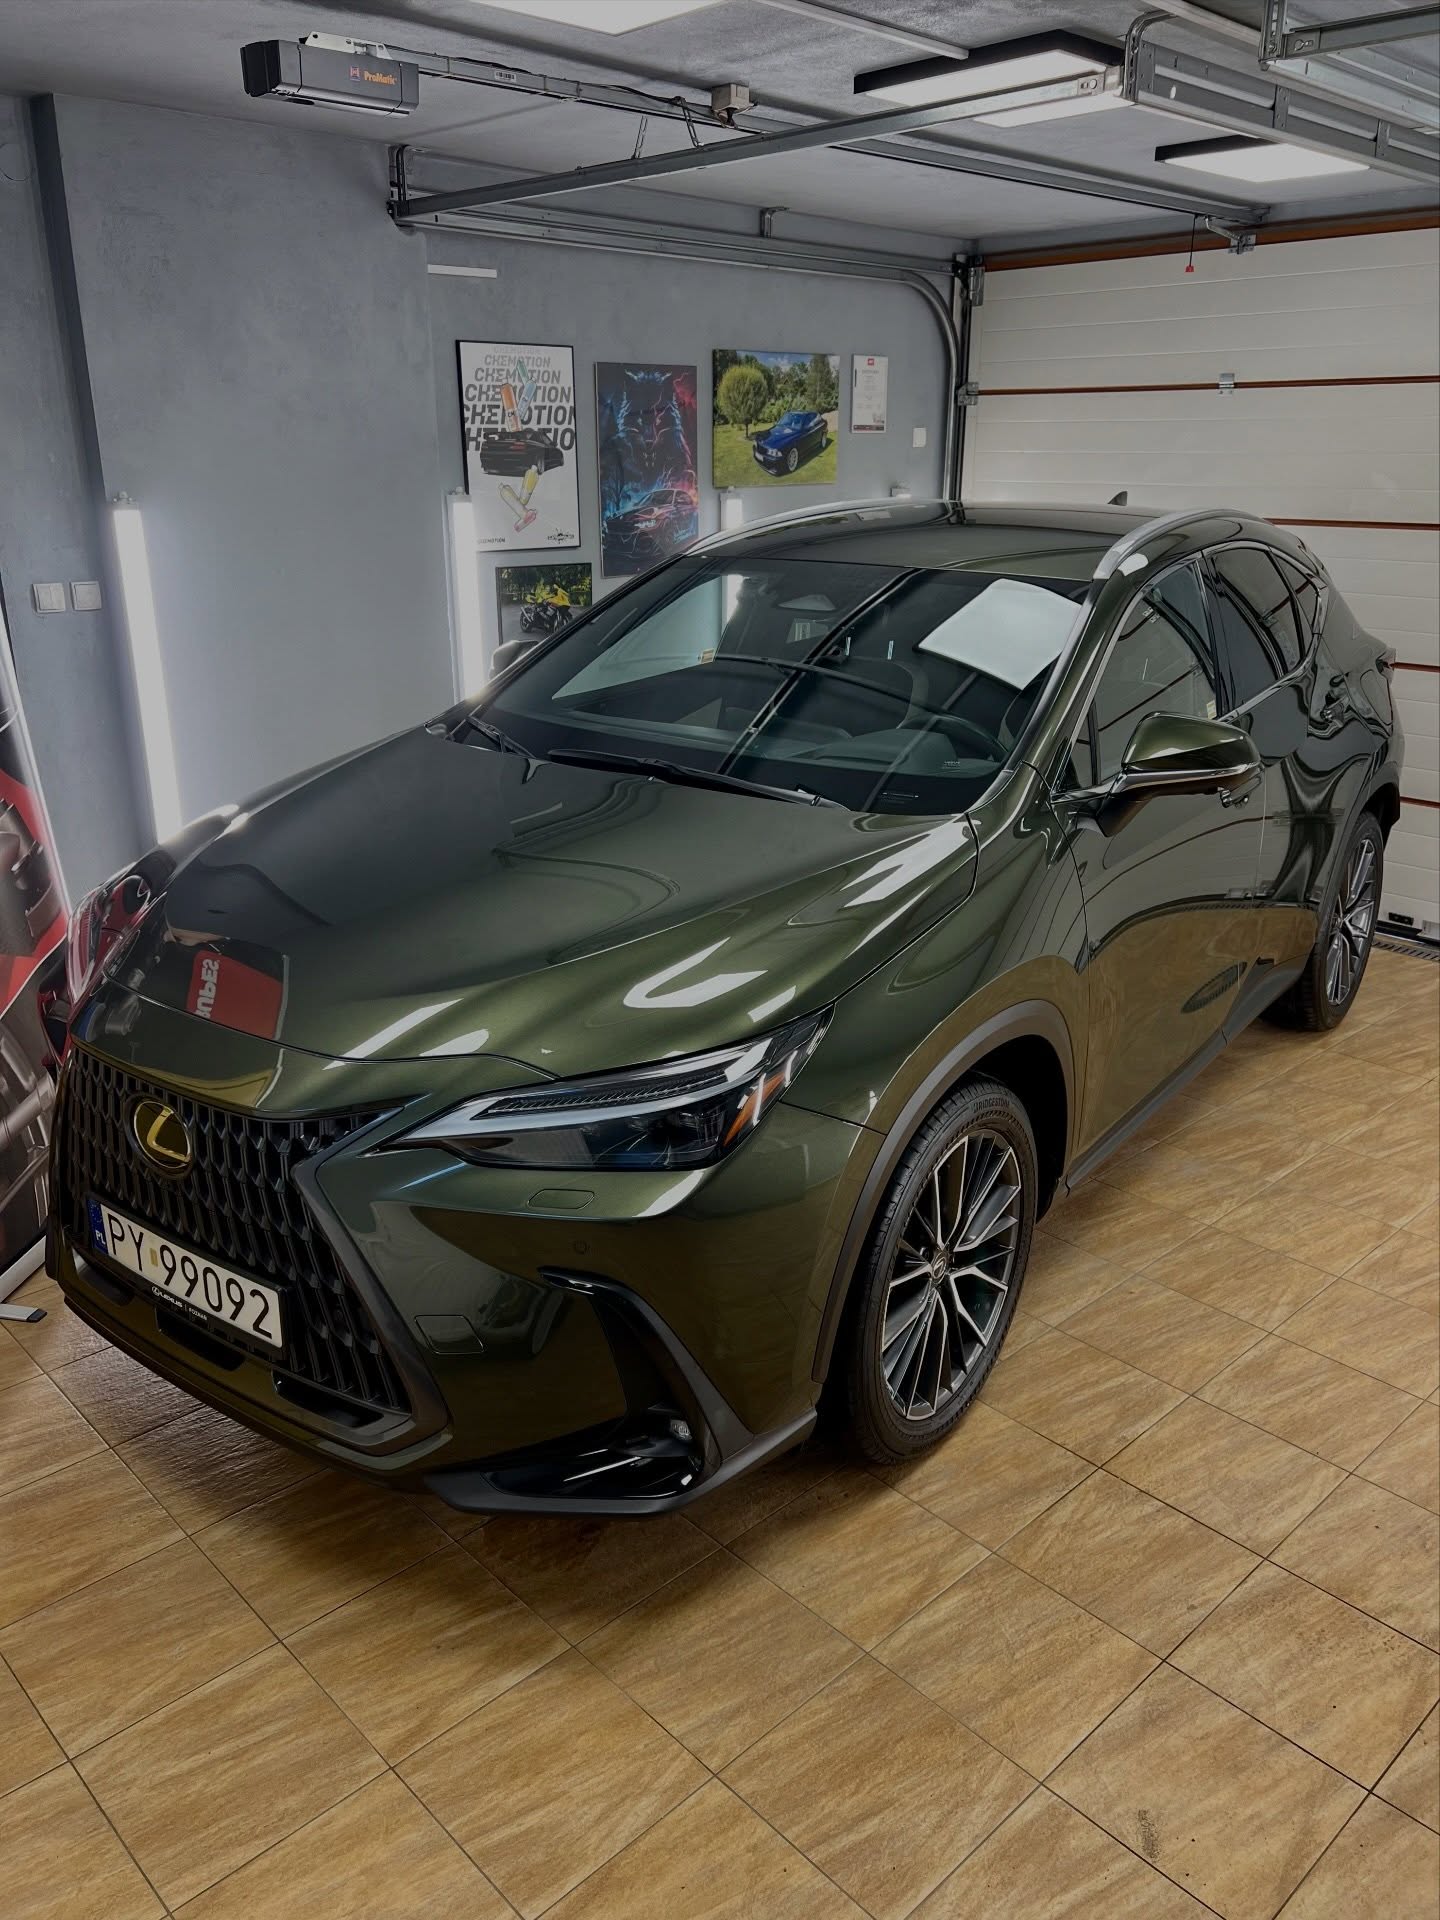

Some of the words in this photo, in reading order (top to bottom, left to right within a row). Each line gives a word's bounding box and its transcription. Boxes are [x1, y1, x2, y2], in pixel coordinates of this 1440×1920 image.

[364, 71, 395, 85] ProMatic
[94, 1229, 106, 1245] PL
[107, 1213, 144, 1272] PY
[159, 1244, 273, 1339] 99092
